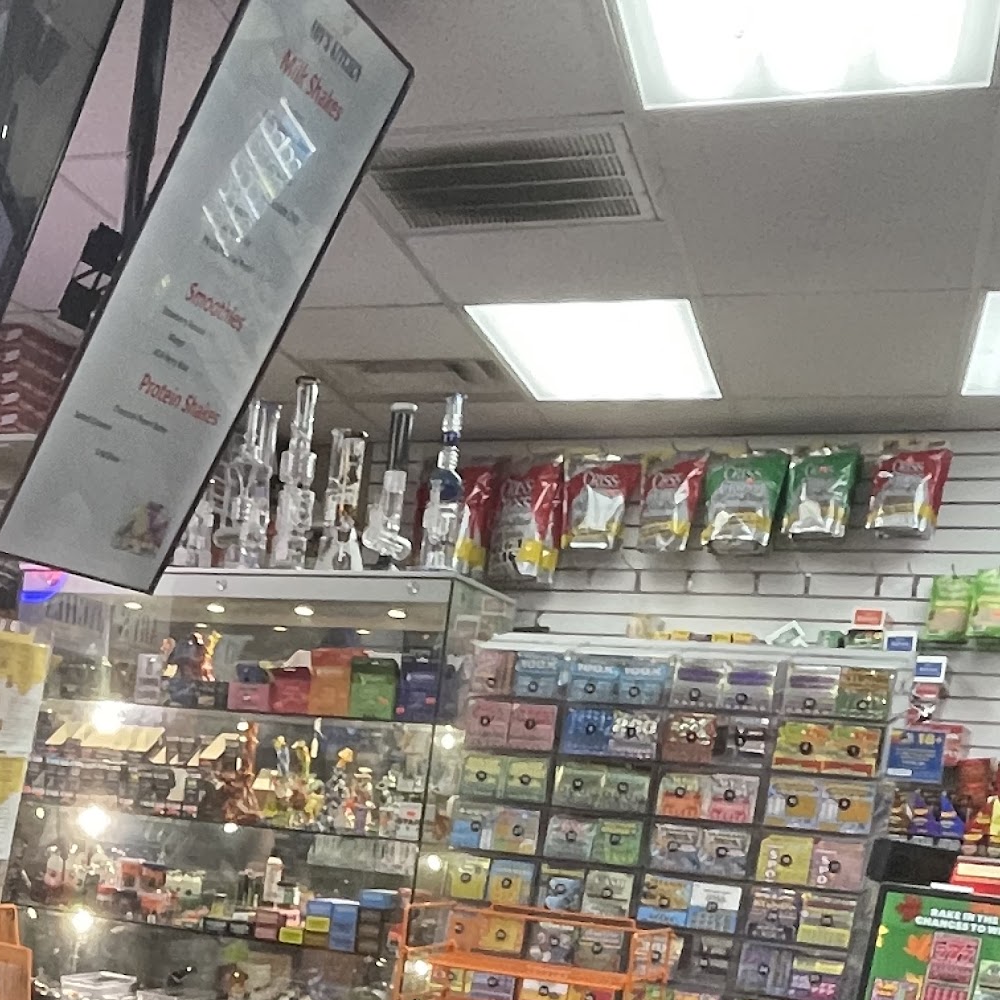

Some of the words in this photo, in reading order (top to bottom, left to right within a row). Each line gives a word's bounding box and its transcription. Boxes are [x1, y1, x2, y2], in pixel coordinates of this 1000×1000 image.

[279, 49, 309, 87] Milk
[306, 73, 343, 121] Shakes
[185, 282, 246, 332] Smoothies
[138, 372, 182, 407] Protein
[181, 394, 221, 426] Shakes
